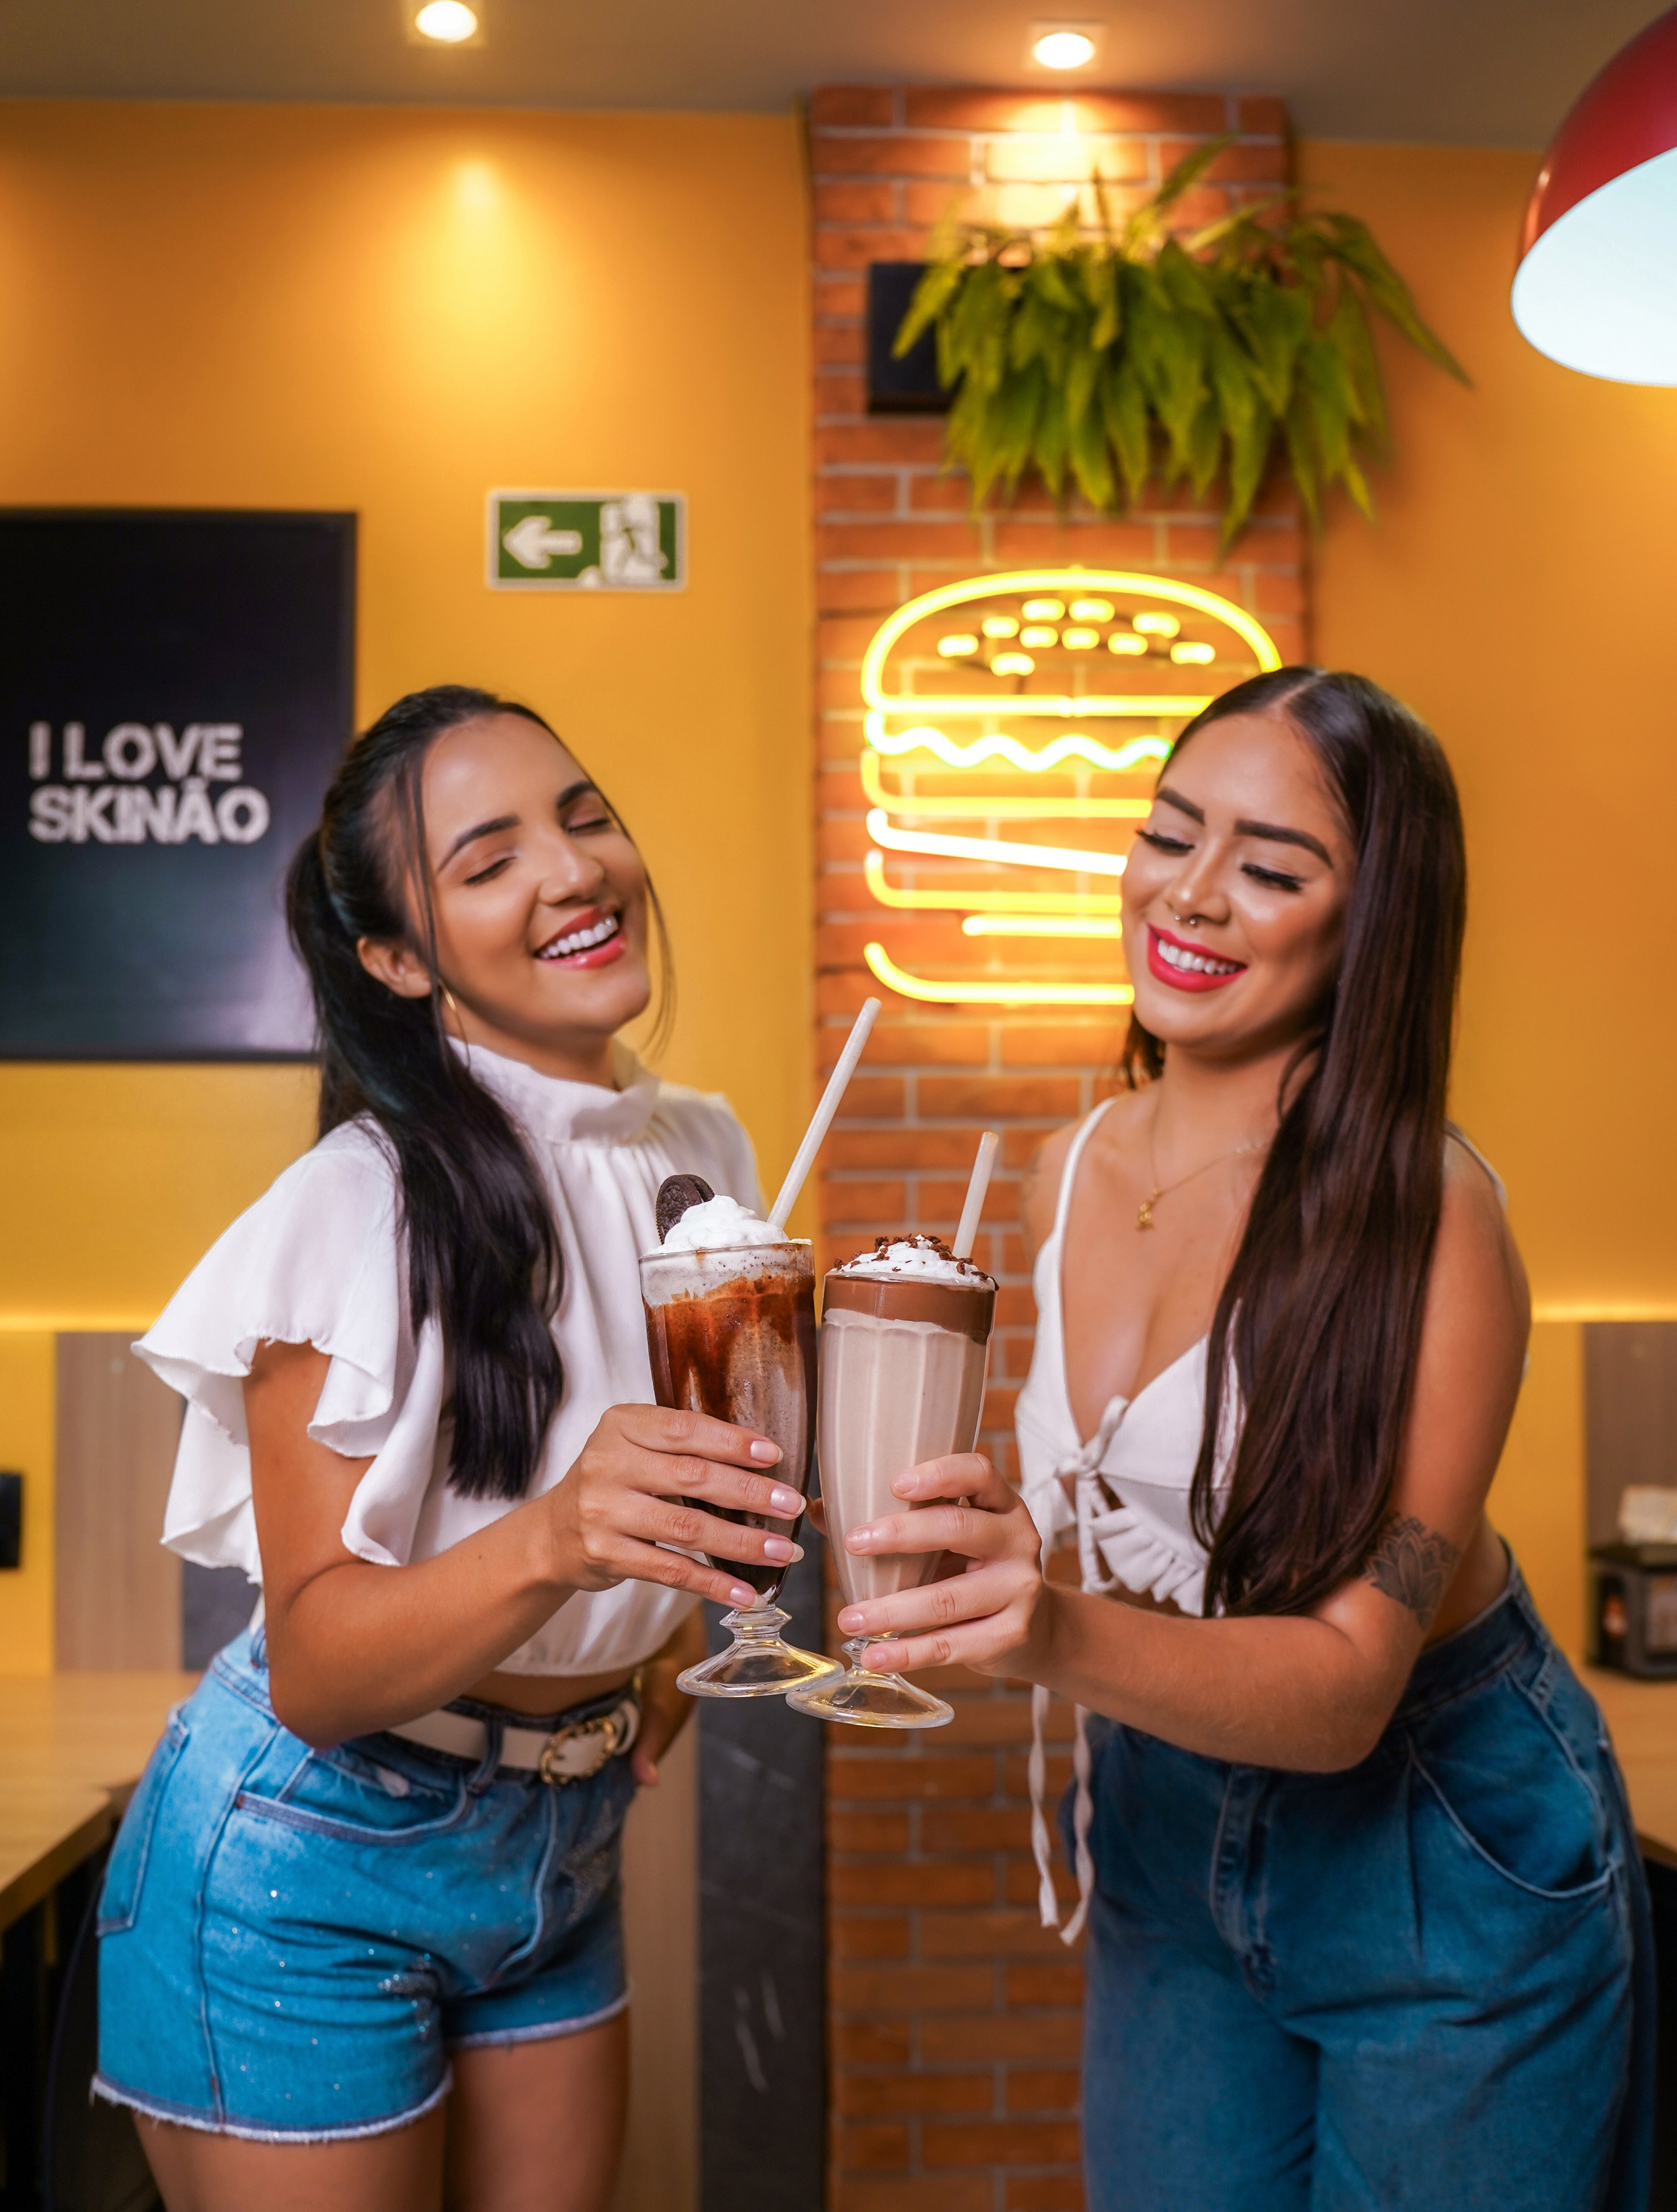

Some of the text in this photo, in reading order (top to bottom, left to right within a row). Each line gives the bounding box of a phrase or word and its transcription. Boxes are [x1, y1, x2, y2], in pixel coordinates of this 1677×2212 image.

[29, 721, 243, 780] I LOVE
[28, 777, 270, 844] SKINÃO
